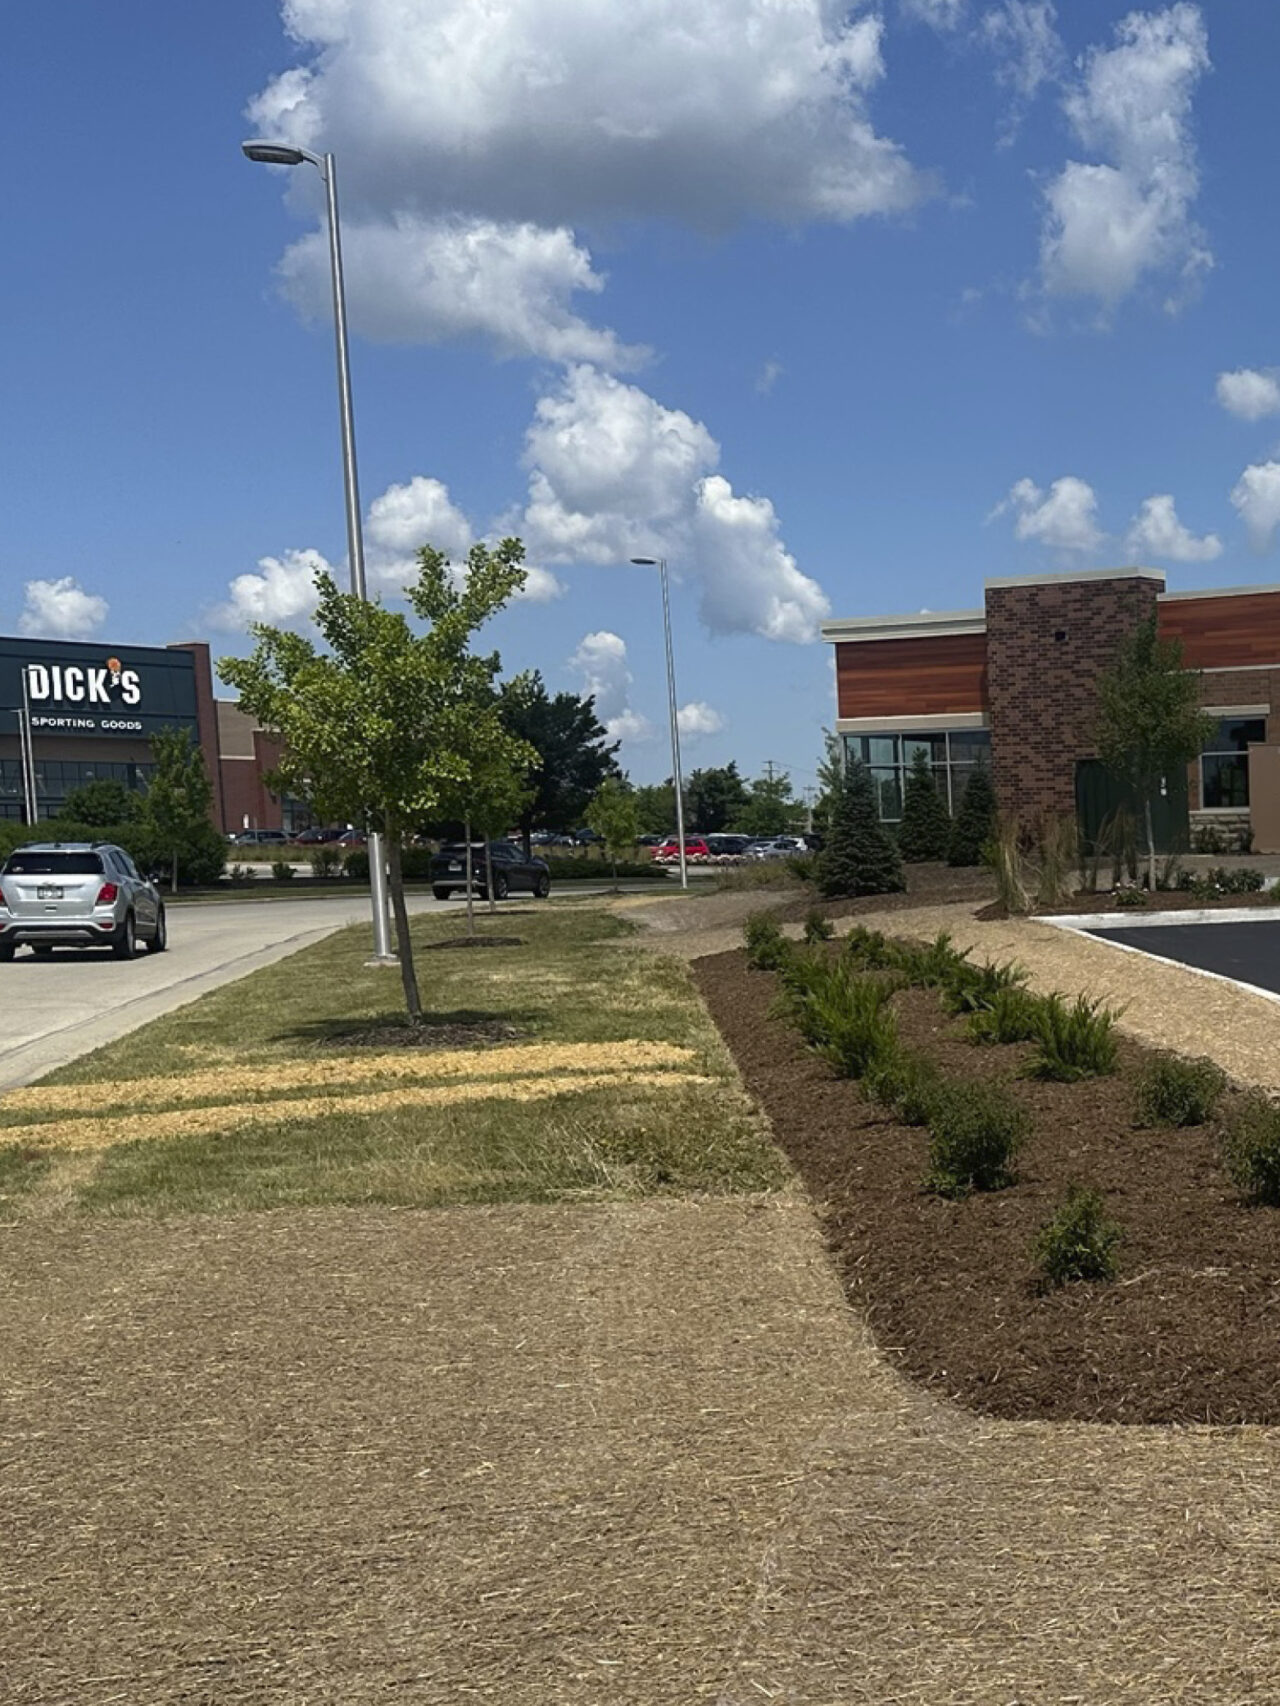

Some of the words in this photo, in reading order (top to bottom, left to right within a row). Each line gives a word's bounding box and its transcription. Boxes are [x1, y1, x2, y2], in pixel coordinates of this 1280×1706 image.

[28, 660, 141, 704] DICK'S
[31, 716, 96, 729] SPORTING
[101, 719, 143, 731] GOODS
